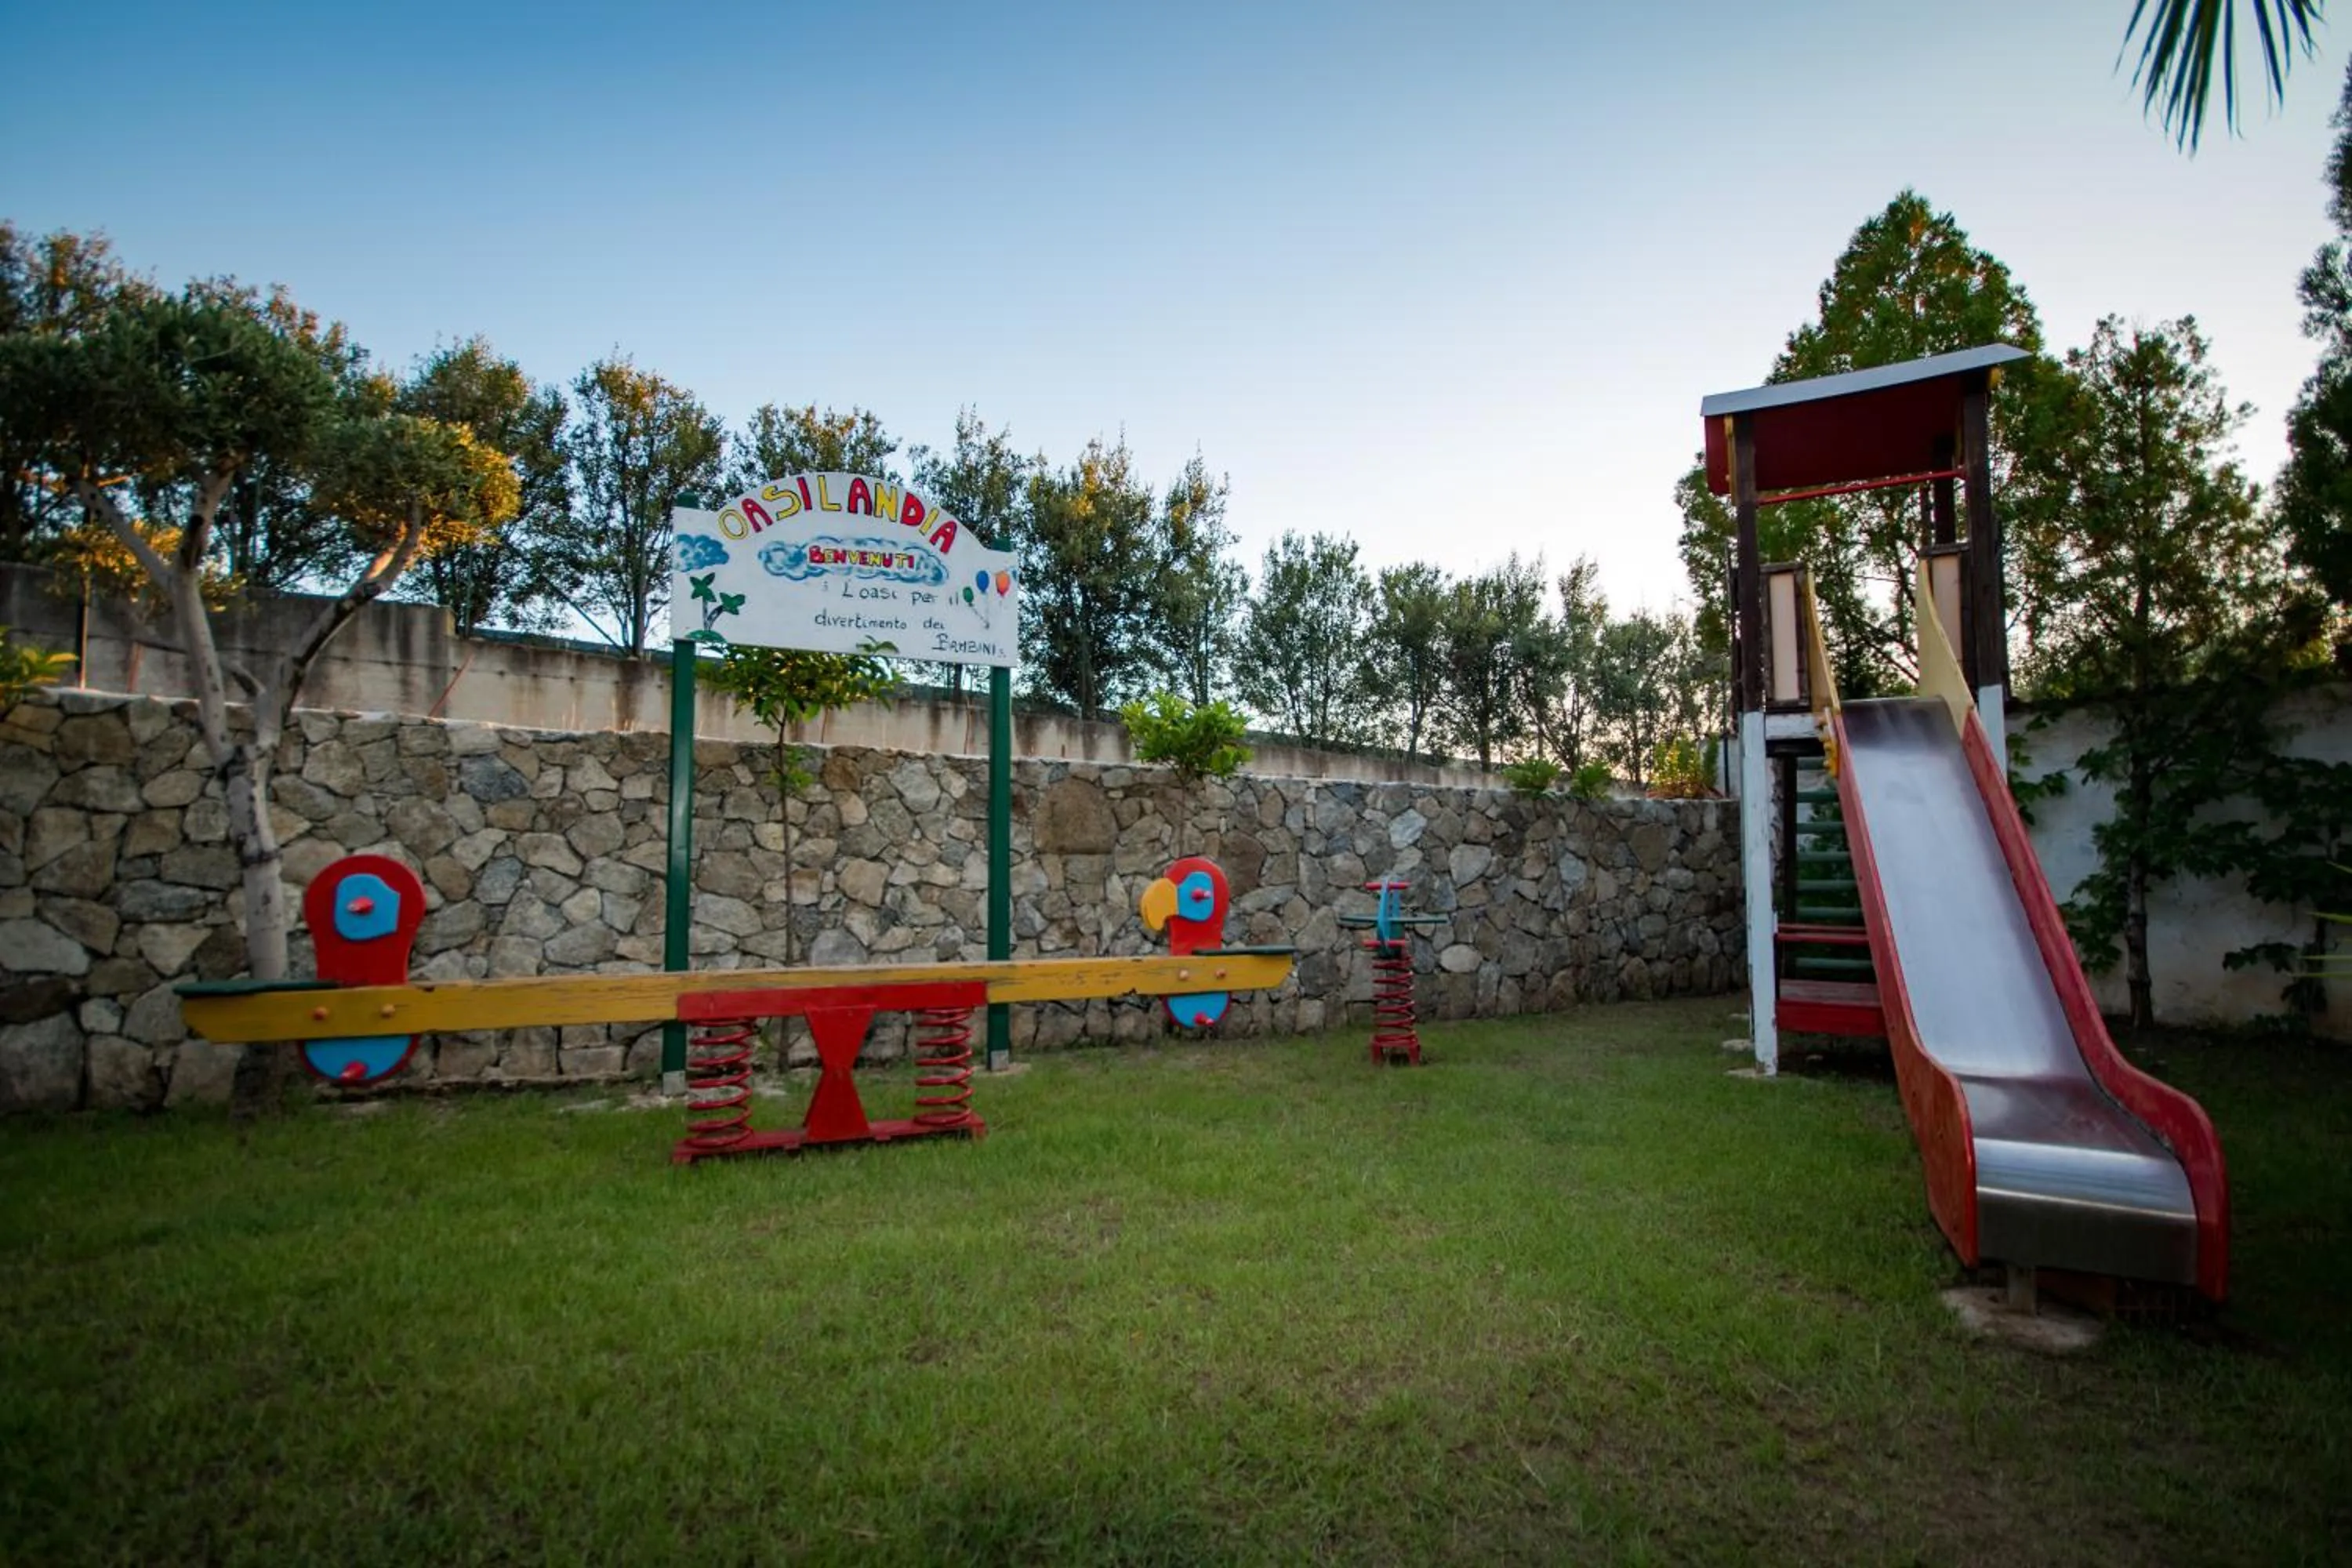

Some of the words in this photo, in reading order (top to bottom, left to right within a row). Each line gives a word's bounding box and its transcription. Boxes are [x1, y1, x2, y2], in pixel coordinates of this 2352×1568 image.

[717, 474, 958, 554] OASILANDIA
[809, 545, 915, 569] BENVENUTI
[912, 590, 938, 606] per
[949, 592, 959, 606] il
[815, 608, 907, 630] divertimento
[923, 617, 945, 630] dei
